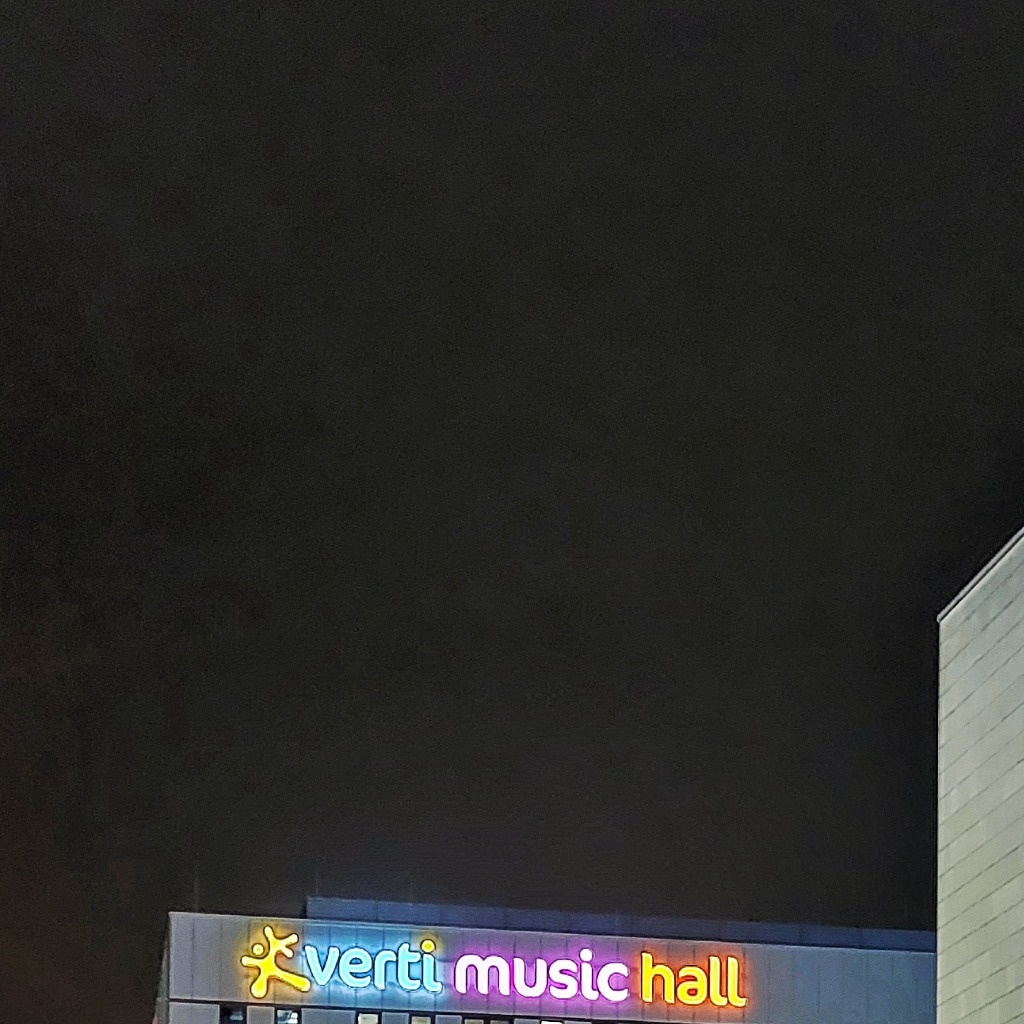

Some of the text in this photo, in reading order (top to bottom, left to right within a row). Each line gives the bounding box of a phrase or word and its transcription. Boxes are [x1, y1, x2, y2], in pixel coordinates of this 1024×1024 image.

[303, 939, 748, 1007] verti music hall
